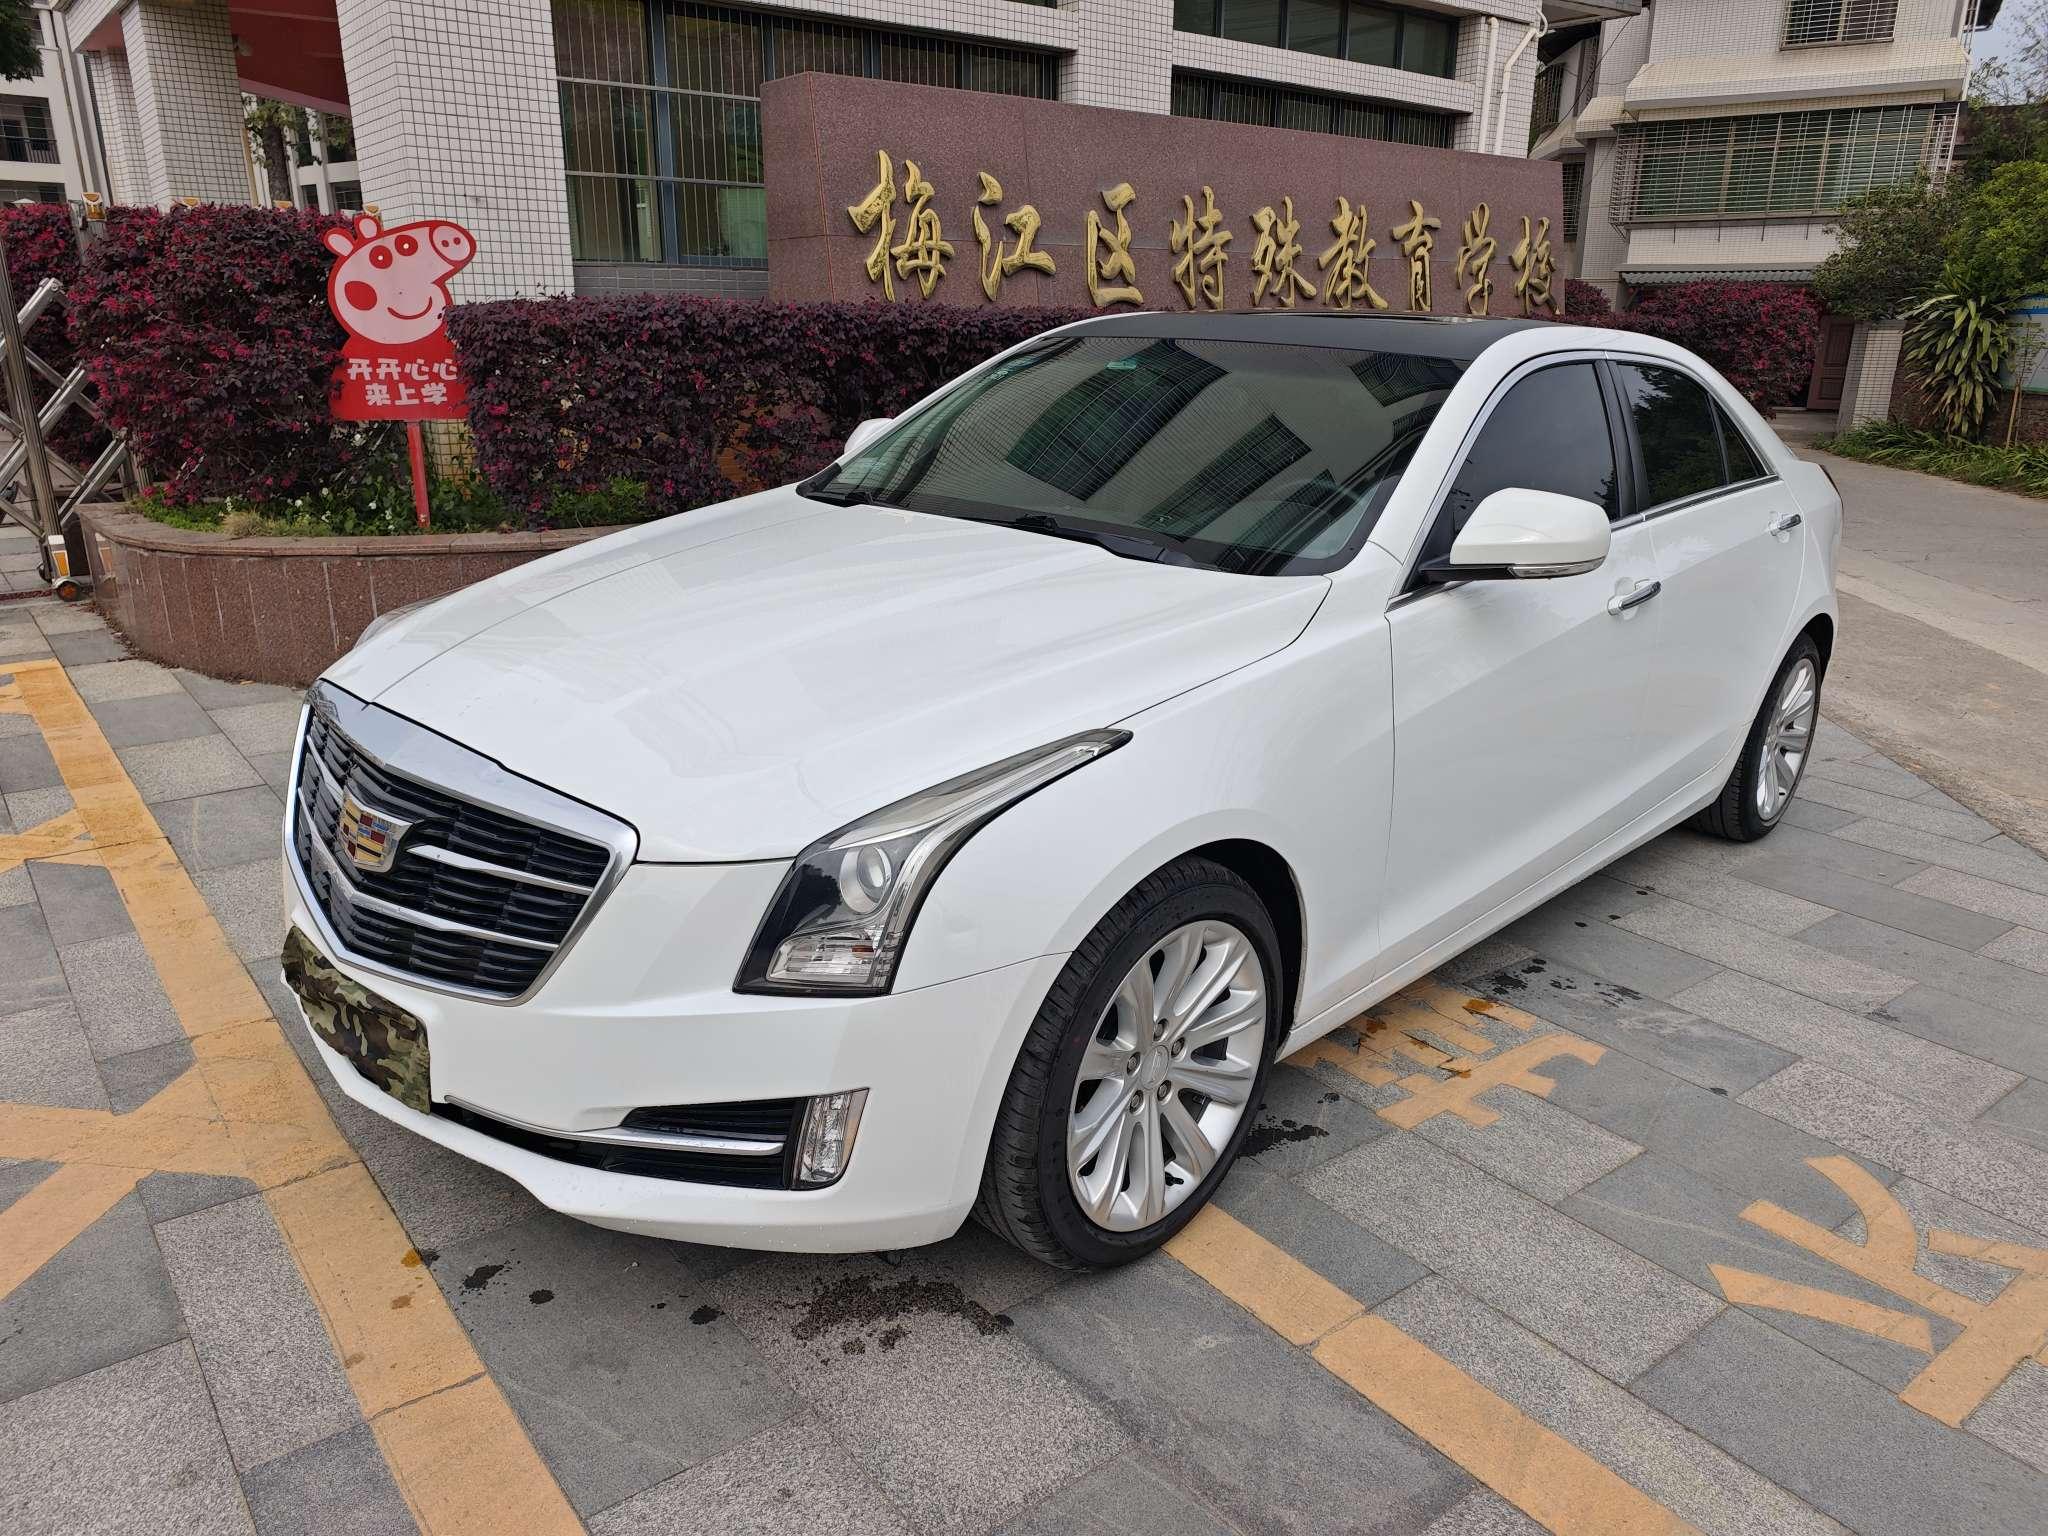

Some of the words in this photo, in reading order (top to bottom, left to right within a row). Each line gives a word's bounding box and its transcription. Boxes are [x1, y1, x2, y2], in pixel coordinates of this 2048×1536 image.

[847, 149, 1561, 316] 梅江区特殊教育学校
[346, 357, 458, 382] 开开心心
[364, 381, 448, 407] 来上学
